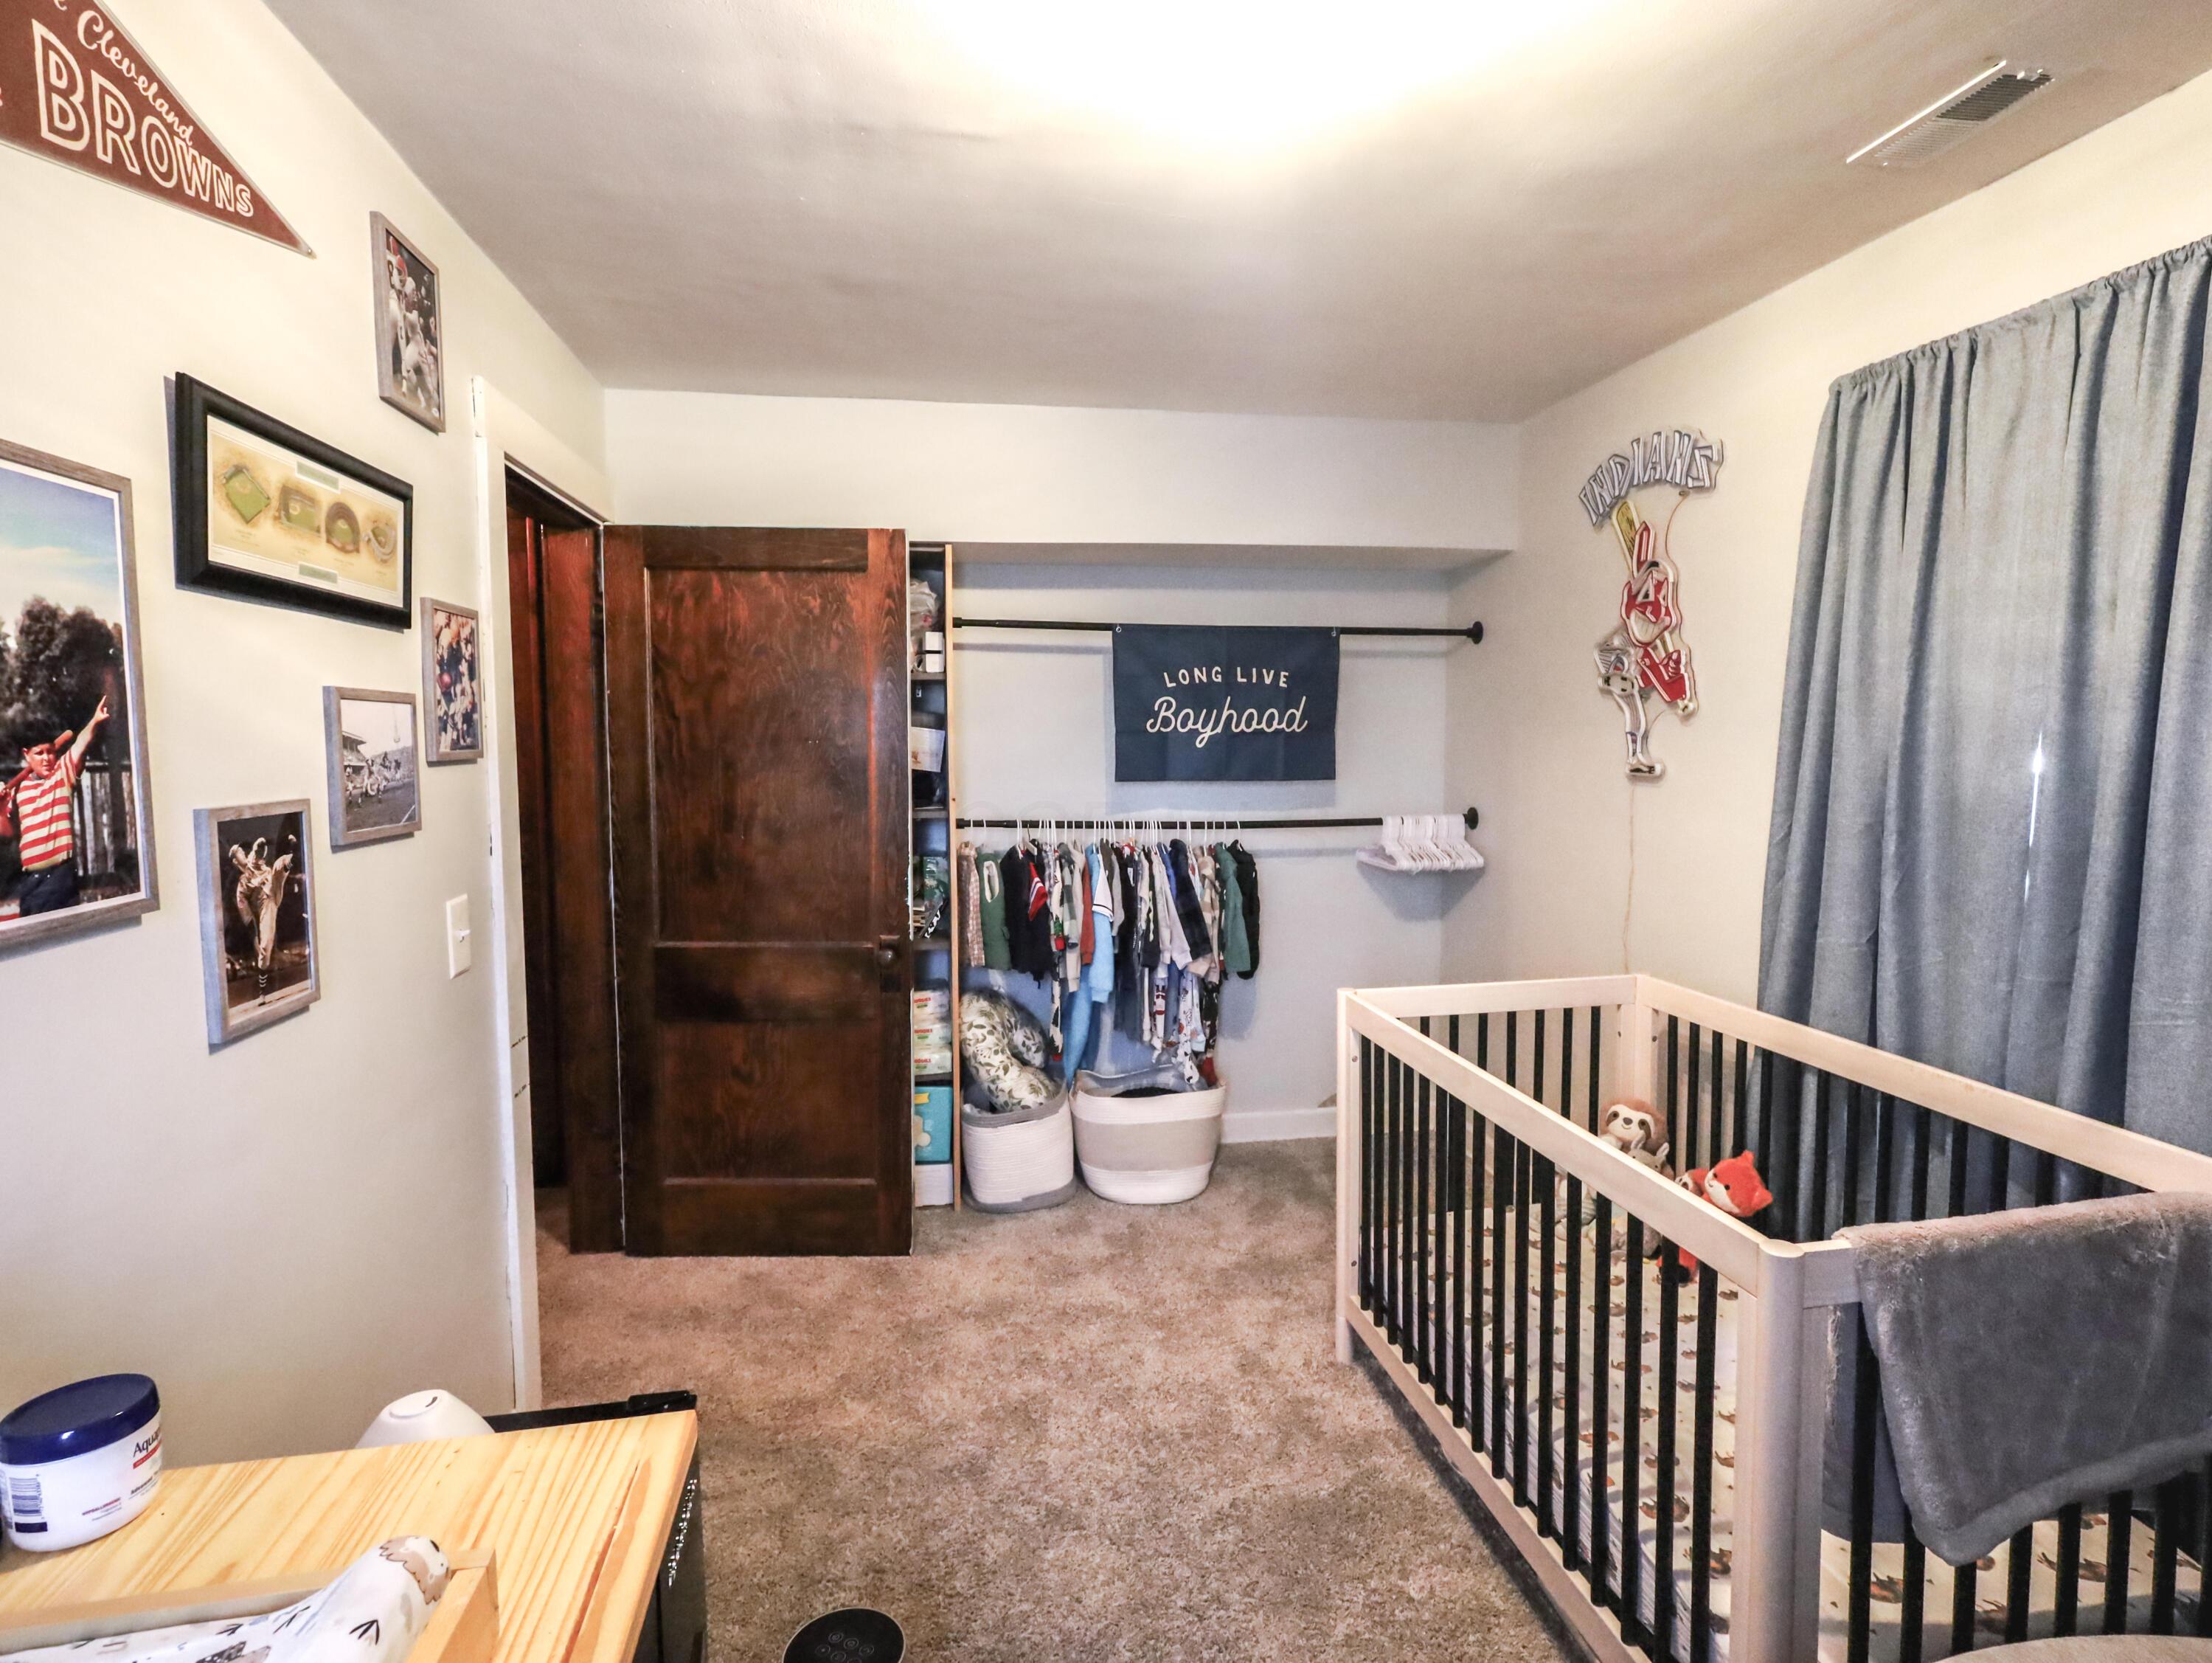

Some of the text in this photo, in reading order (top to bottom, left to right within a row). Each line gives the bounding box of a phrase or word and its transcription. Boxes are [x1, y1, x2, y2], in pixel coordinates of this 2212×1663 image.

[31, 18, 254, 217] BROWNS
[77, 10, 194, 146] Cleveland
[1578, 429, 1719, 526] INDIANS
[1145, 696, 1308, 748] Boyhood
[1163, 665, 1289, 688] LONG LIVE
